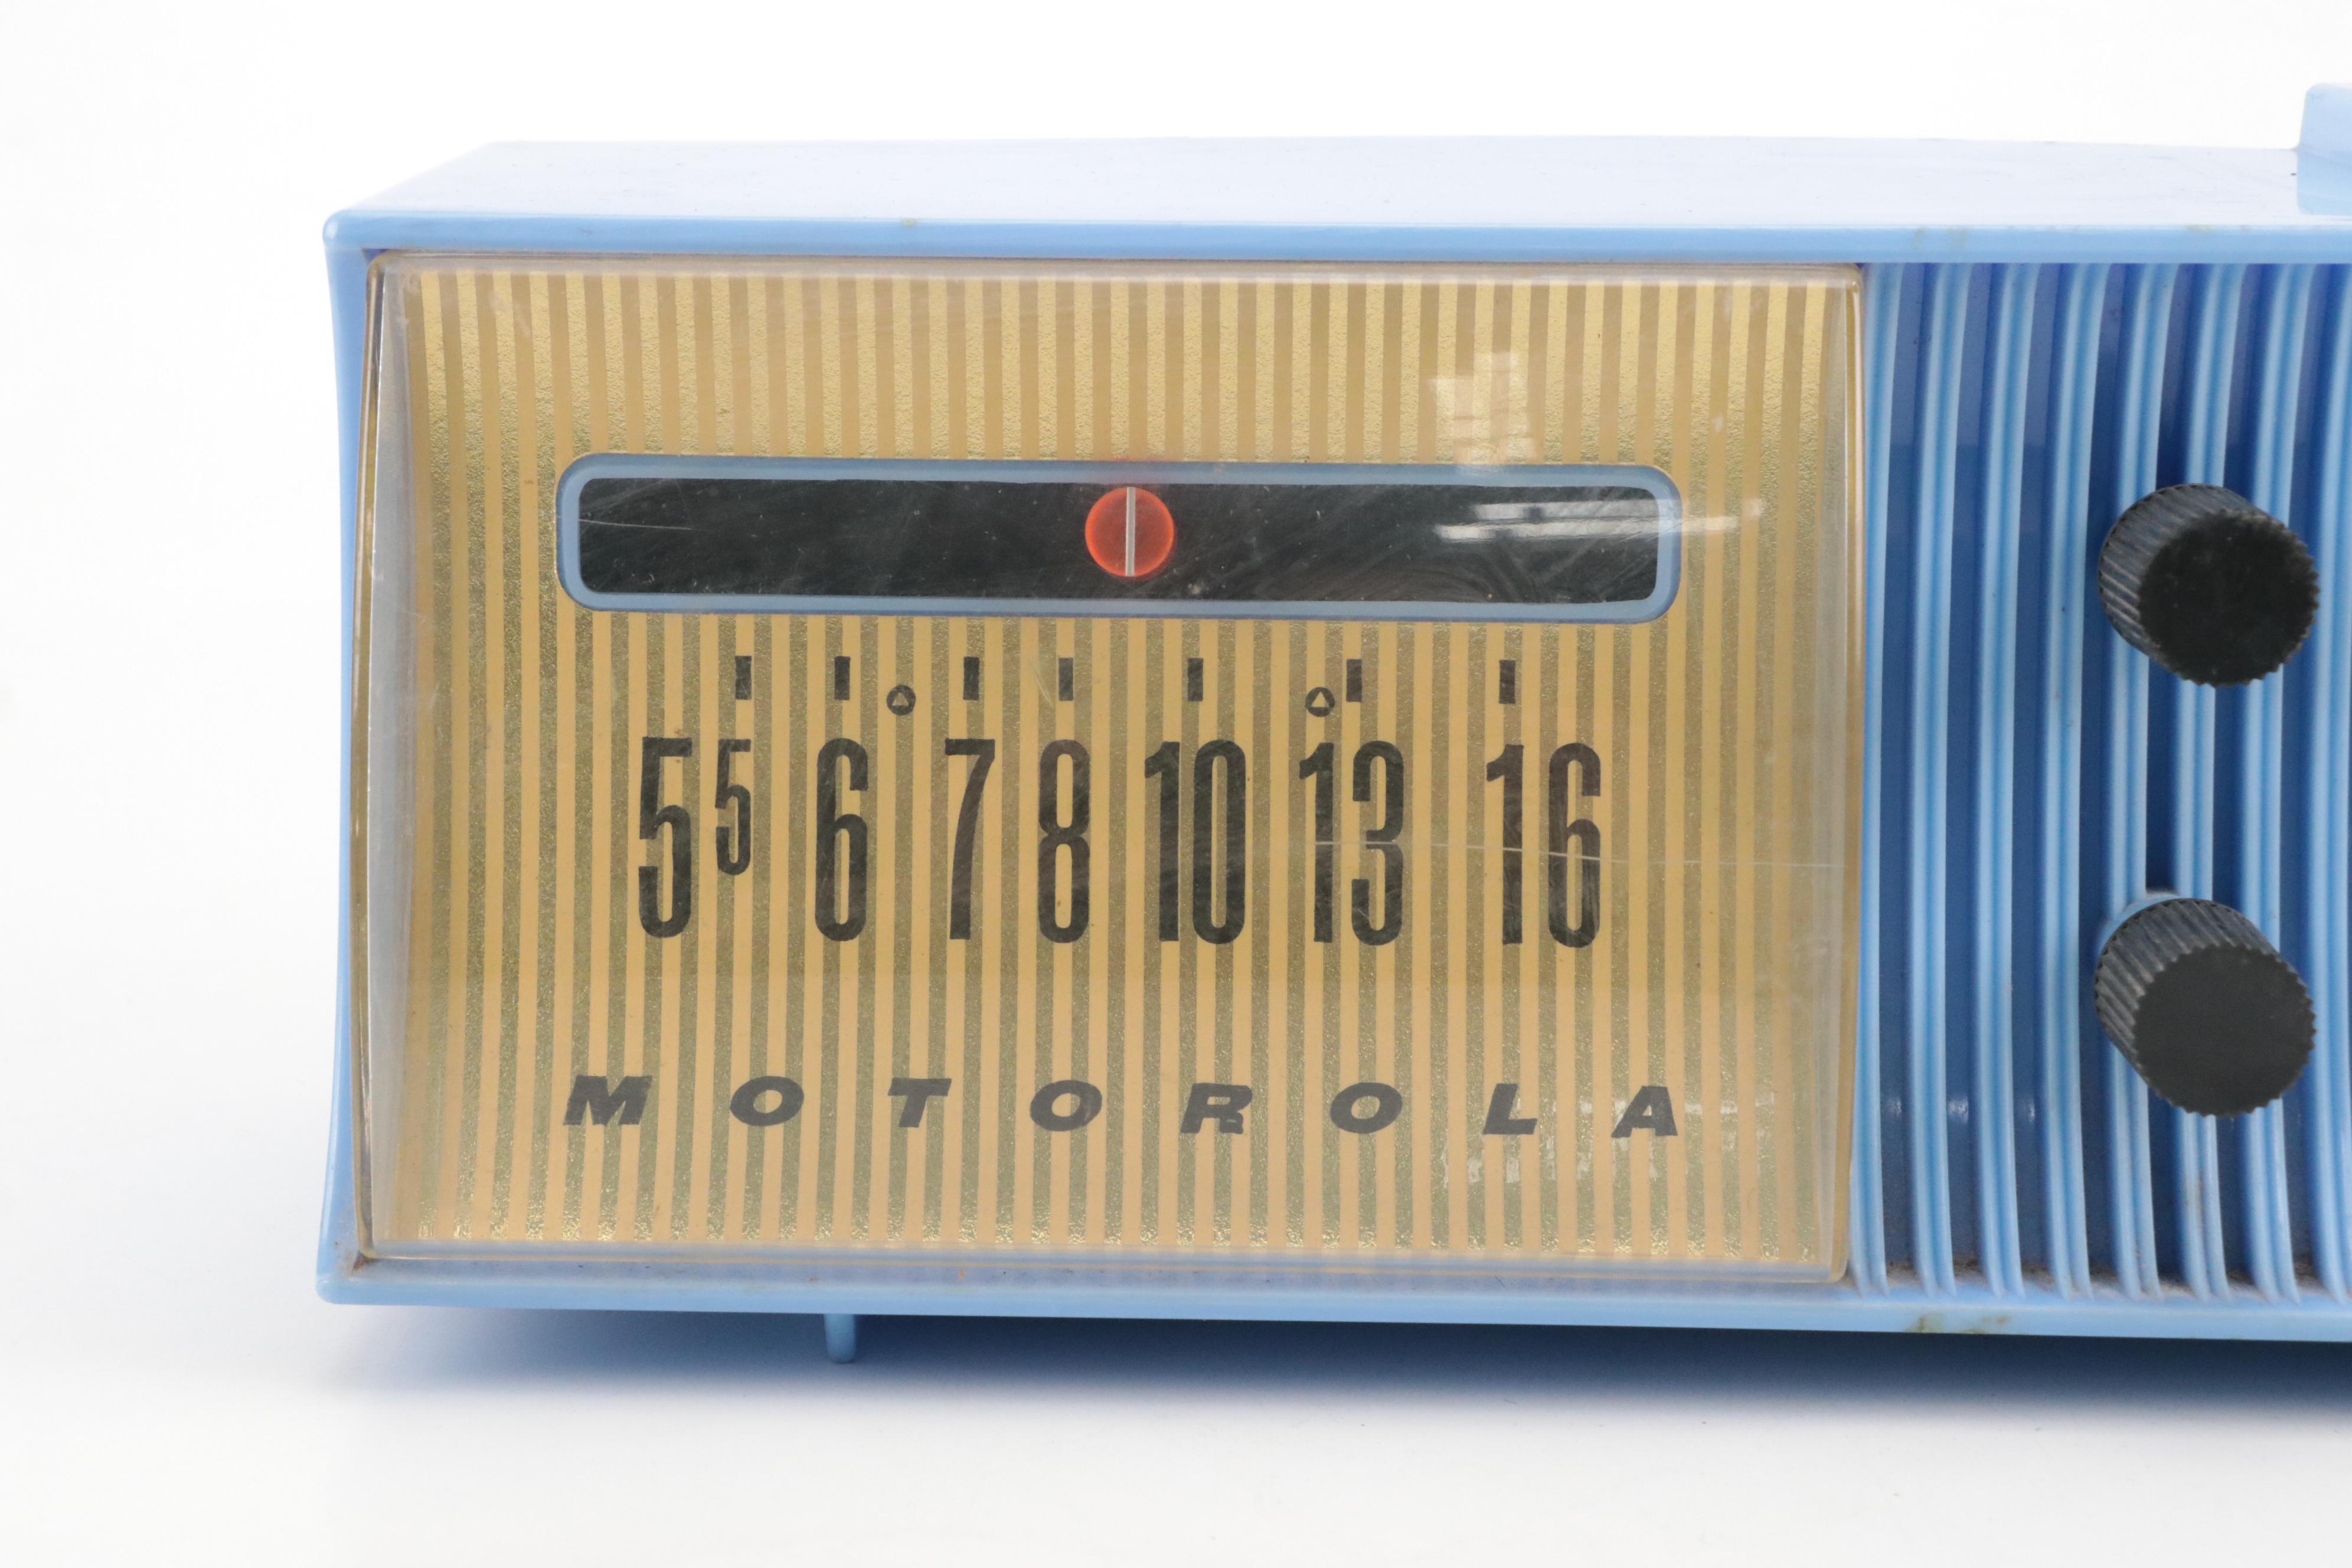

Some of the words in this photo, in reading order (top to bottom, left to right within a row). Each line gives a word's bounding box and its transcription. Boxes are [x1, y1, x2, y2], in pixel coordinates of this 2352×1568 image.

[815, 738, 869, 942] 6
[944, 737, 995, 940] 7
[1038, 740, 1090, 943] 8
[1144, 739, 1246, 945] 10
[1299, 740, 1404, 946] 13
[1486, 742, 1600, 948] 16
[565, 1074, 1678, 1137] MOTOROLA
